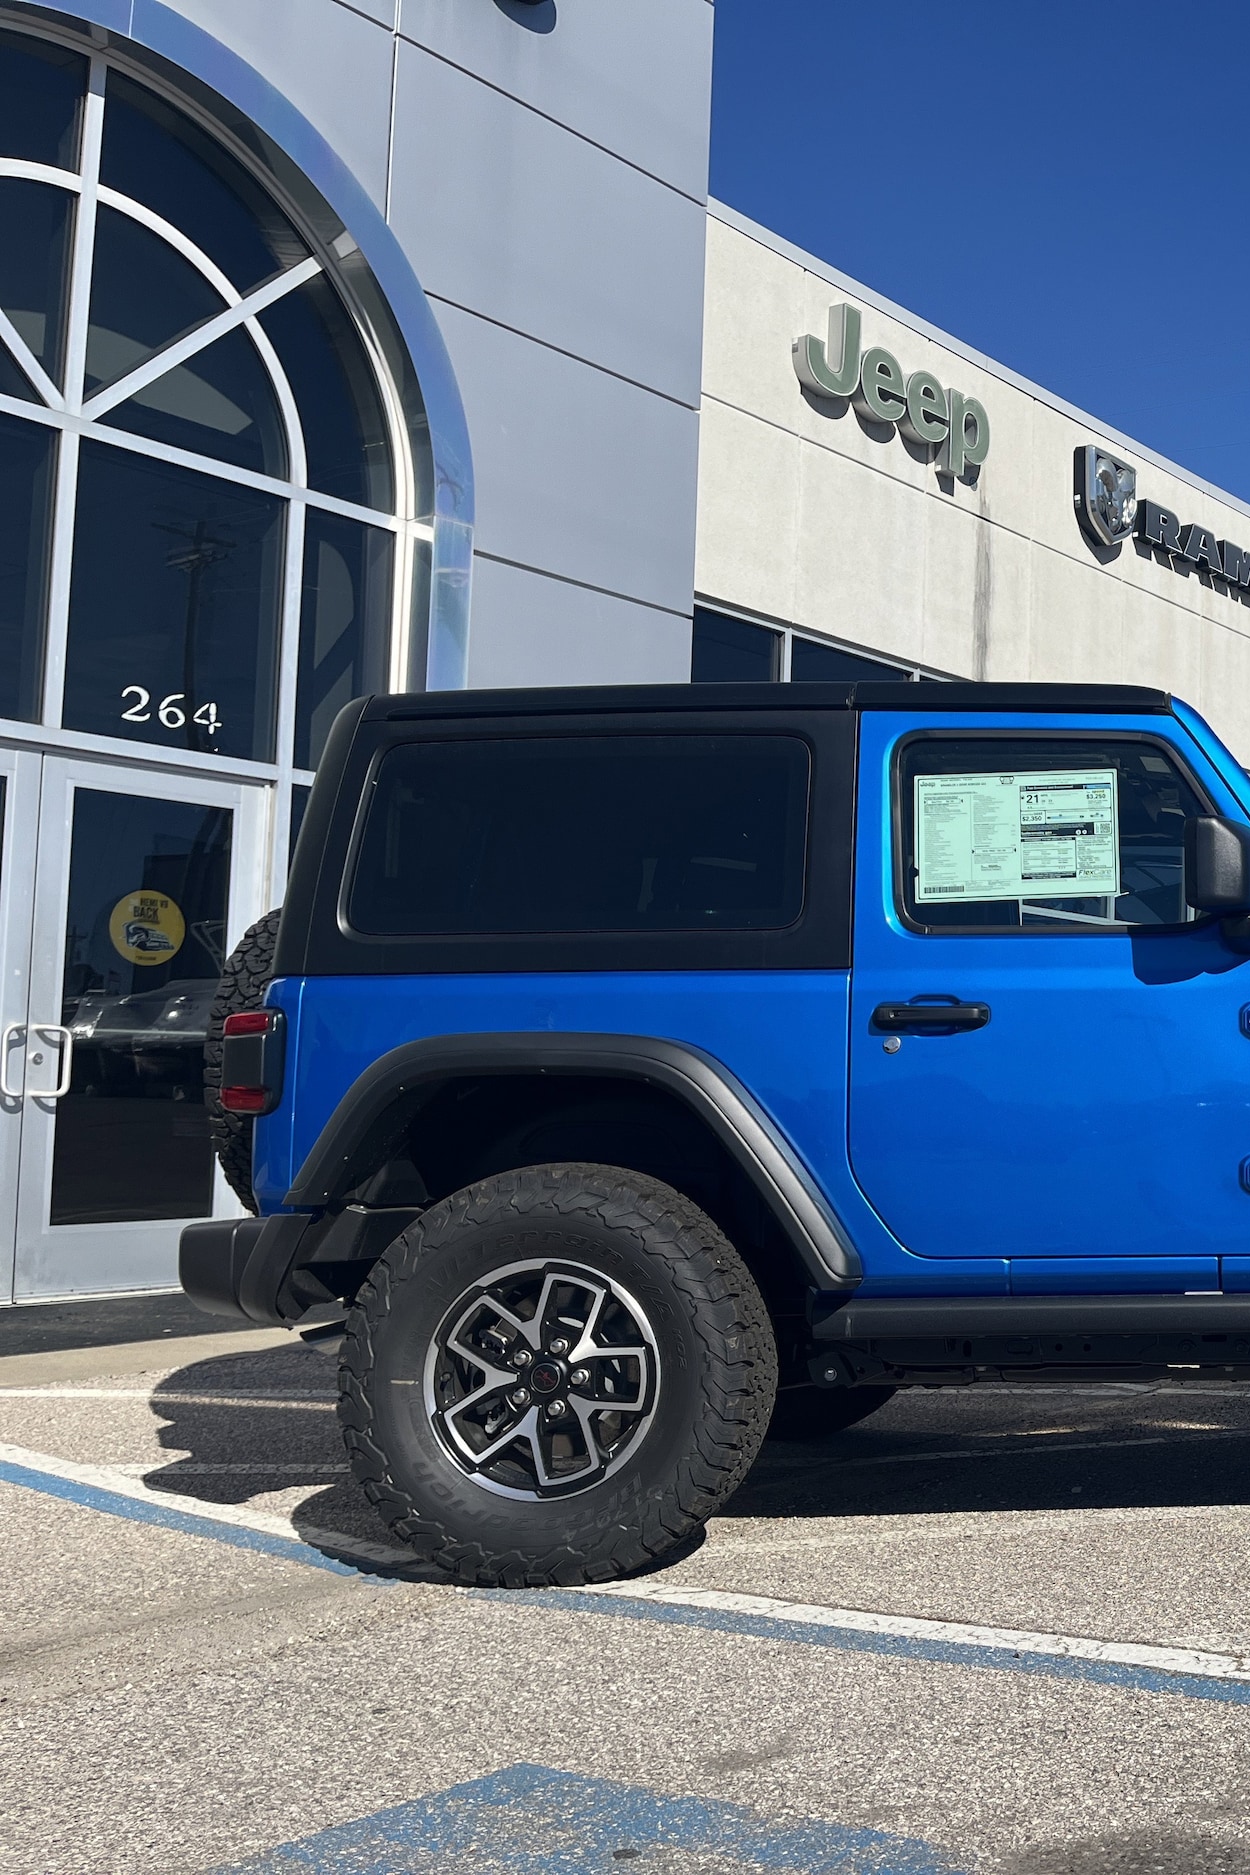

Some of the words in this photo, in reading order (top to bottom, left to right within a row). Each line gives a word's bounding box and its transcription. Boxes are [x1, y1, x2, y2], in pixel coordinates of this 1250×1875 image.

[794, 303, 990, 477] Jeep
[121, 685, 223, 735] 264
[1026, 794, 1039, 804] 21
[133, 906, 159, 921] BACK
